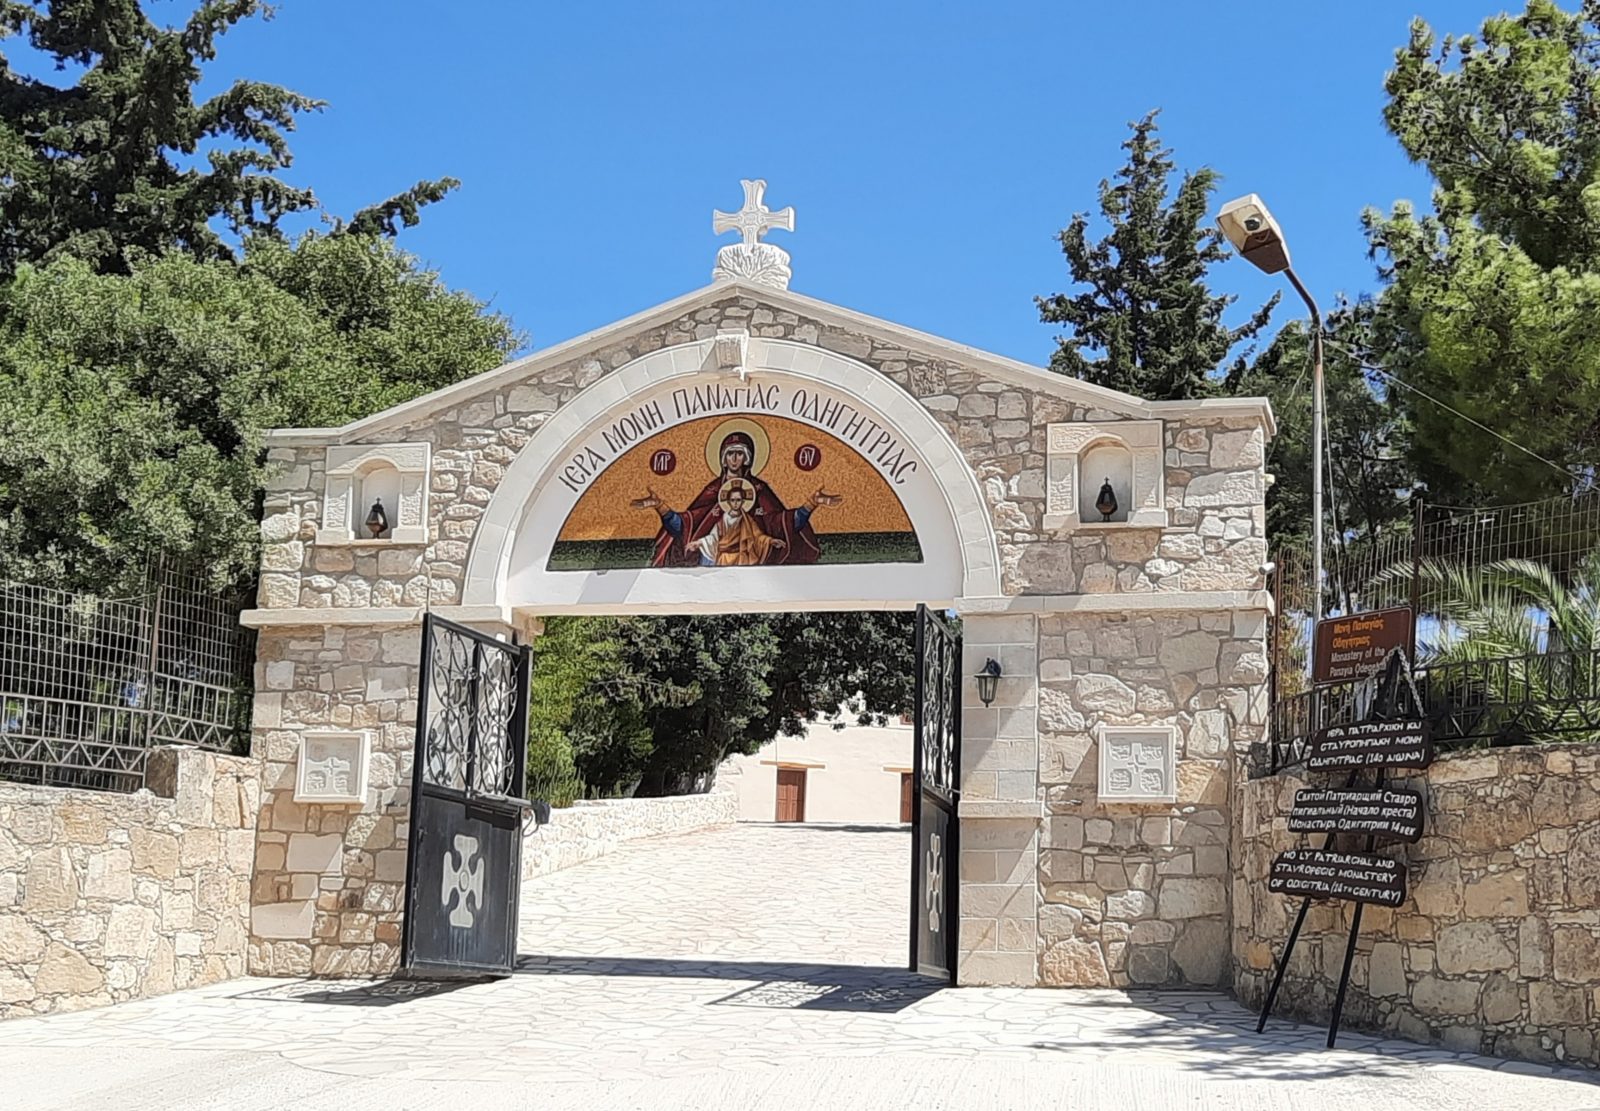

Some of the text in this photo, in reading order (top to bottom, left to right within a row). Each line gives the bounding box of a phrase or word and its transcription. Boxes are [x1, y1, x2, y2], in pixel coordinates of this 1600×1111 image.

[602, 400, 665, 453] ΜΟΝΗ
[1330, 646, 1385, 662] Monastery of the
[1406, 721, 1422, 730] ΚΑΙ
[1395, 735, 1423, 745] ΜΟΝΗ
[1296, 789, 1326, 802] Святой
[1383, 791, 1417, 806] Ставро
[1343, 804, 1380, 816] (Начало
[1381, 806, 1417, 819] креста)
[1288, 818, 1336, 831] Монастырь
[1338, 818, 1389, 831] Одигитрии
[1314, 852, 1373, 867] PATRIARCHAL
[1375, 859, 1395, 869] AND
[1338, 869, 1397, 883] MONASTERY
[1270, 878, 1284, 888] OF
[1286, 879, 1330, 892] ODIGITRIA
